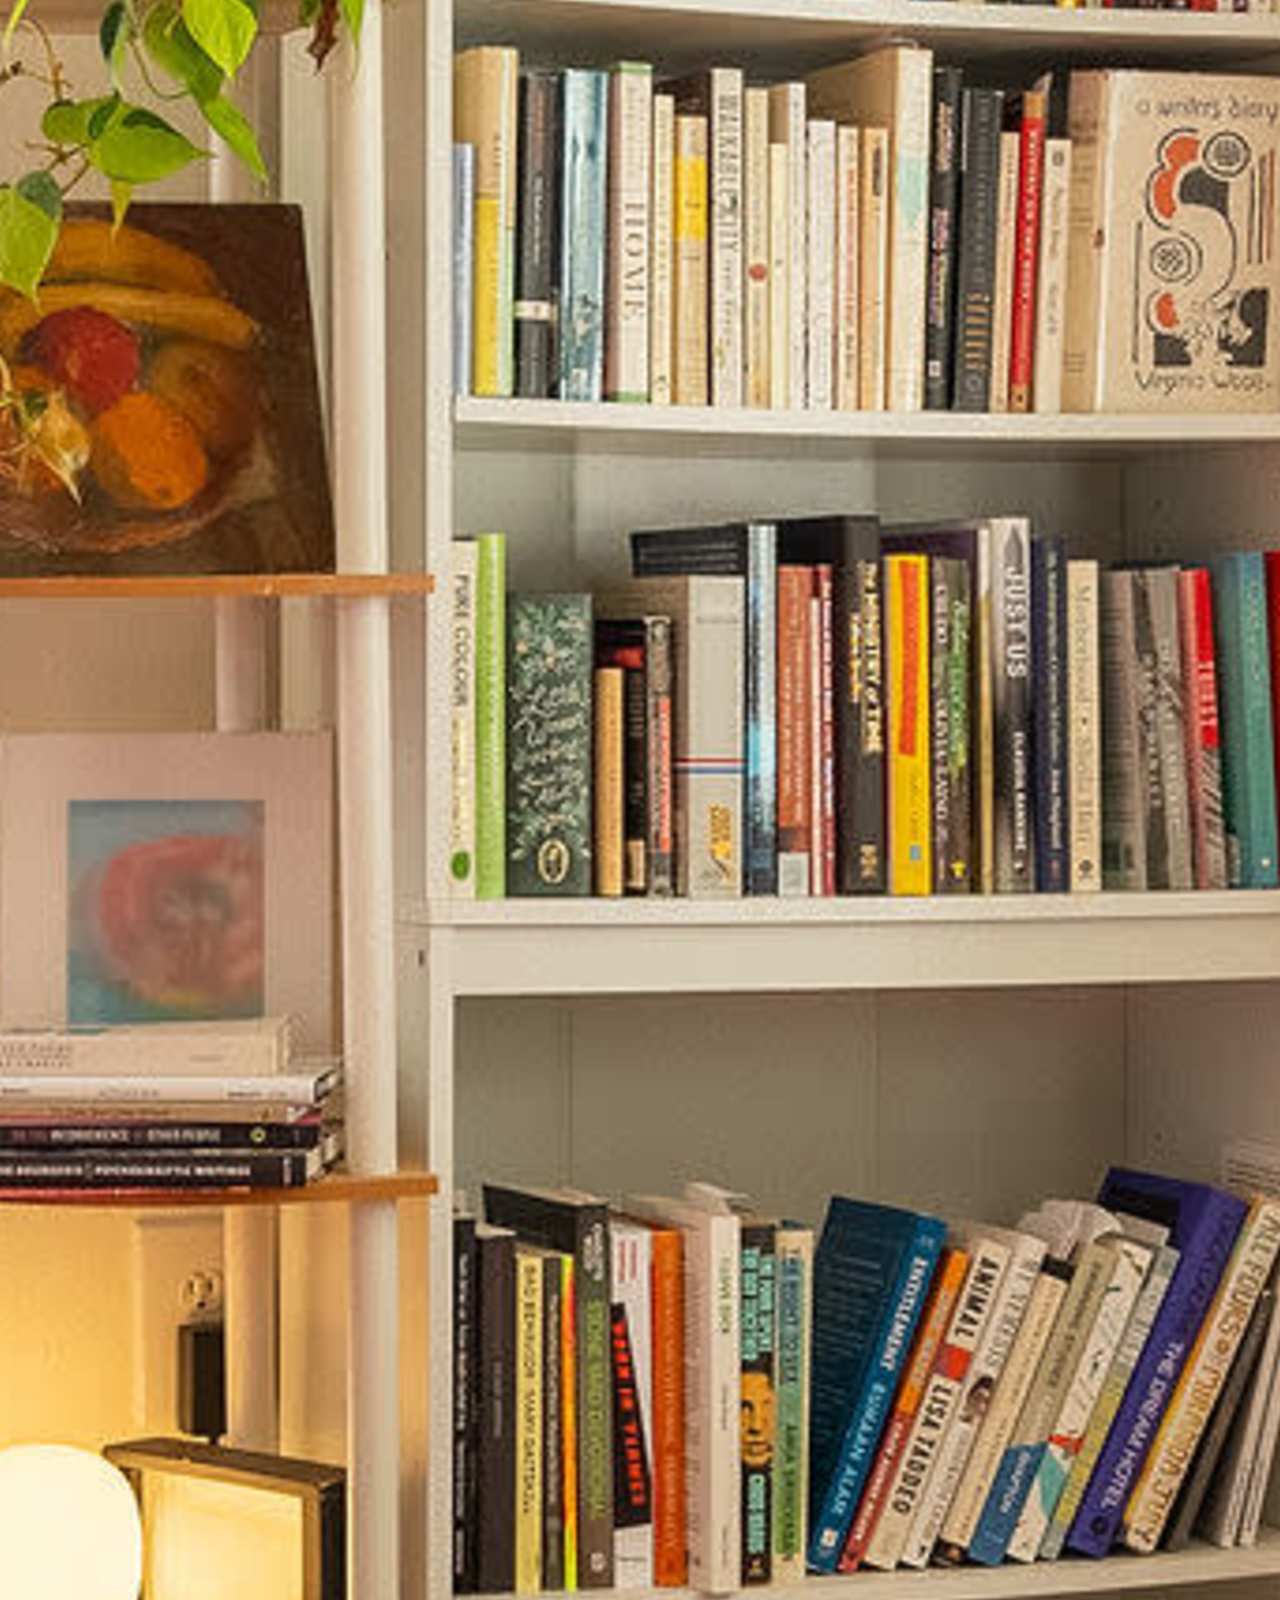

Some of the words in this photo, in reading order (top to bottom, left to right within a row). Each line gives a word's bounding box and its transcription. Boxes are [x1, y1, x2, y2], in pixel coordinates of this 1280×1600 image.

[622, 202, 647, 321] HOME
[1005, 565, 1027, 635] JUST
[453, 626, 471, 709] COLOUR
[1005, 643, 1027, 679] US
[879, 1256, 930, 1373] ENTITLEMENT
[952, 1256, 998, 1339] ANIMAL
[1216, 1261, 1265, 1339] FOURS
[1154, 1339, 1185, 1377] THE
[920, 1384, 953, 1430] LISA
[891, 1436, 935, 1517] TADDEO
[1099, 1446, 1140, 1511] HOTEL
